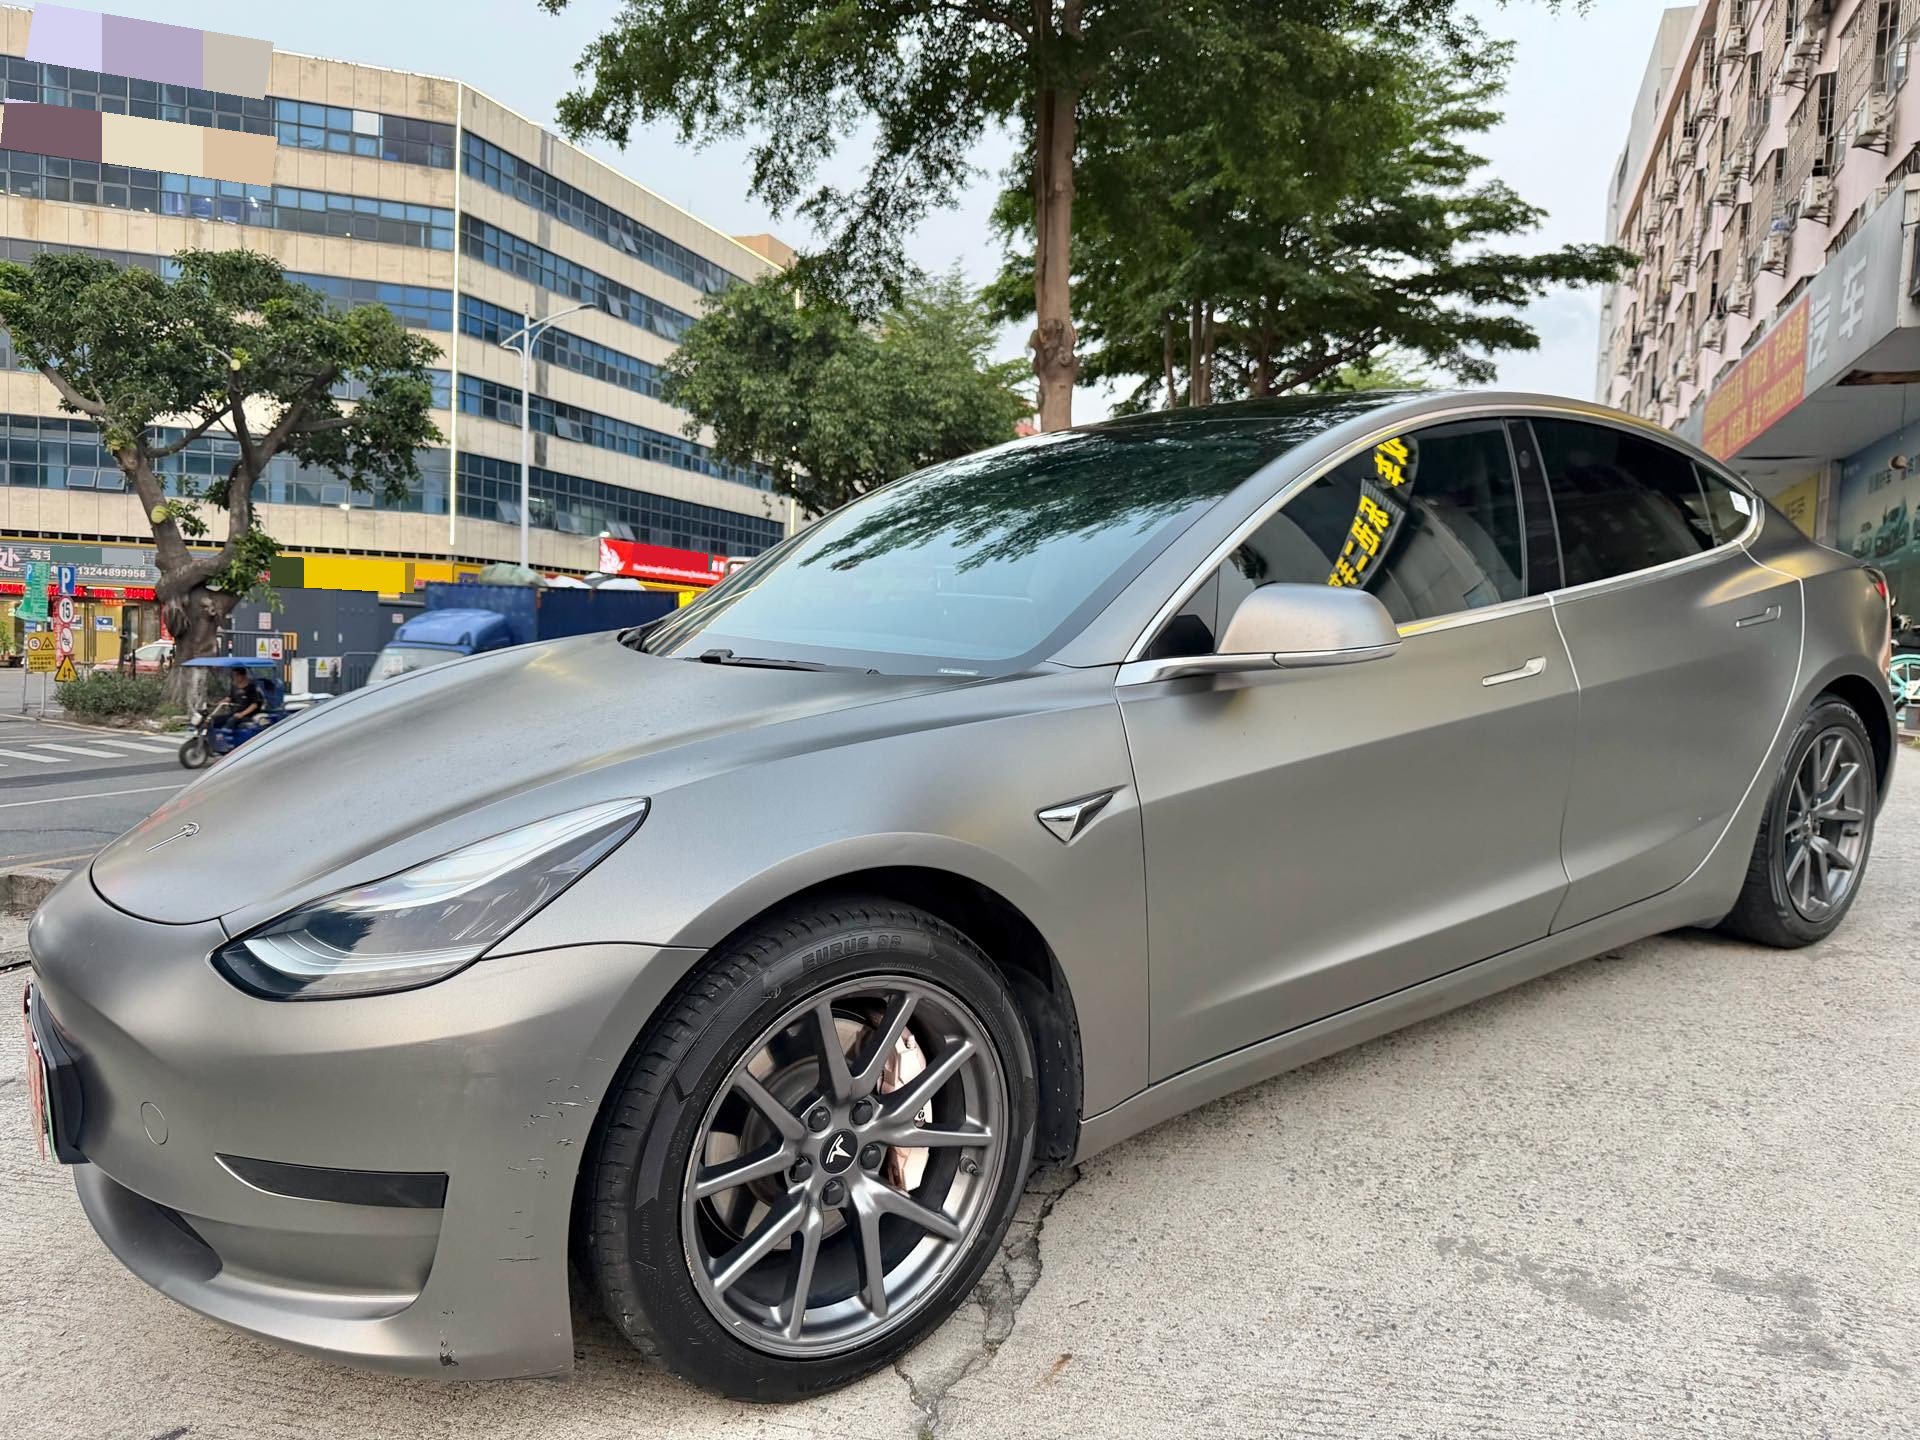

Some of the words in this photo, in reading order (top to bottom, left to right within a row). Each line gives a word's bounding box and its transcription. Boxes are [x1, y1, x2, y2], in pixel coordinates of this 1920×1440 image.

[1806, 255, 1867, 374] 汽车
[61, 566, 71, 593] P
[78, 566, 147, 579] 13244899958
[61, 601, 71, 619] 15
